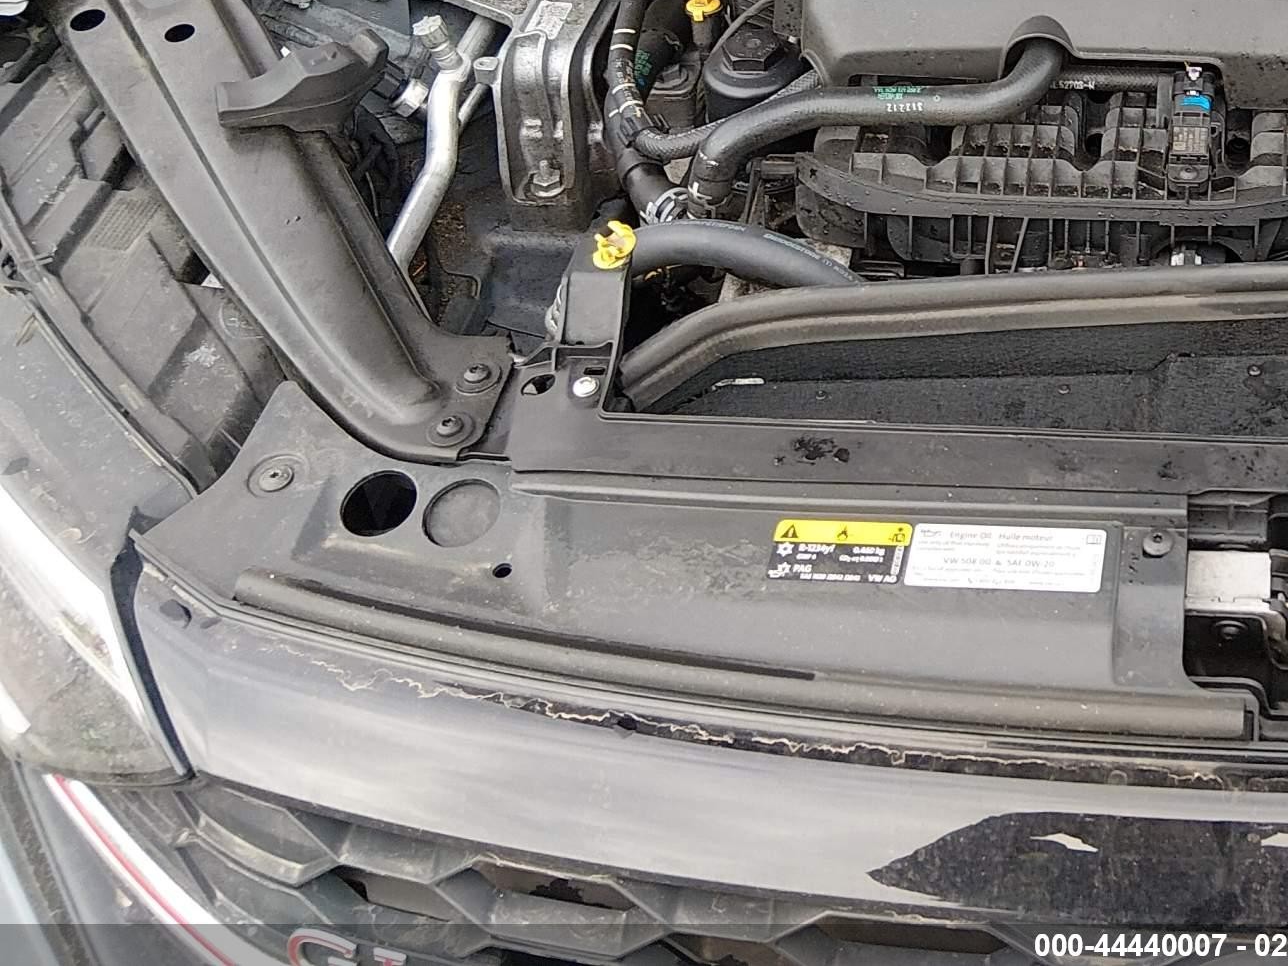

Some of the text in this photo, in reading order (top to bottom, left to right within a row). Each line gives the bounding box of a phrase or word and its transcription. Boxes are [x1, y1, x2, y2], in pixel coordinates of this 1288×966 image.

[950, 530, 978, 540] Engine
[999, 532, 1021, 541] Huile
[943, 557, 959, 565] VW
[792, 564, 813, 573] PAG
[867, 573, 883, 583] VW
[882, 574, 898, 584] AG
